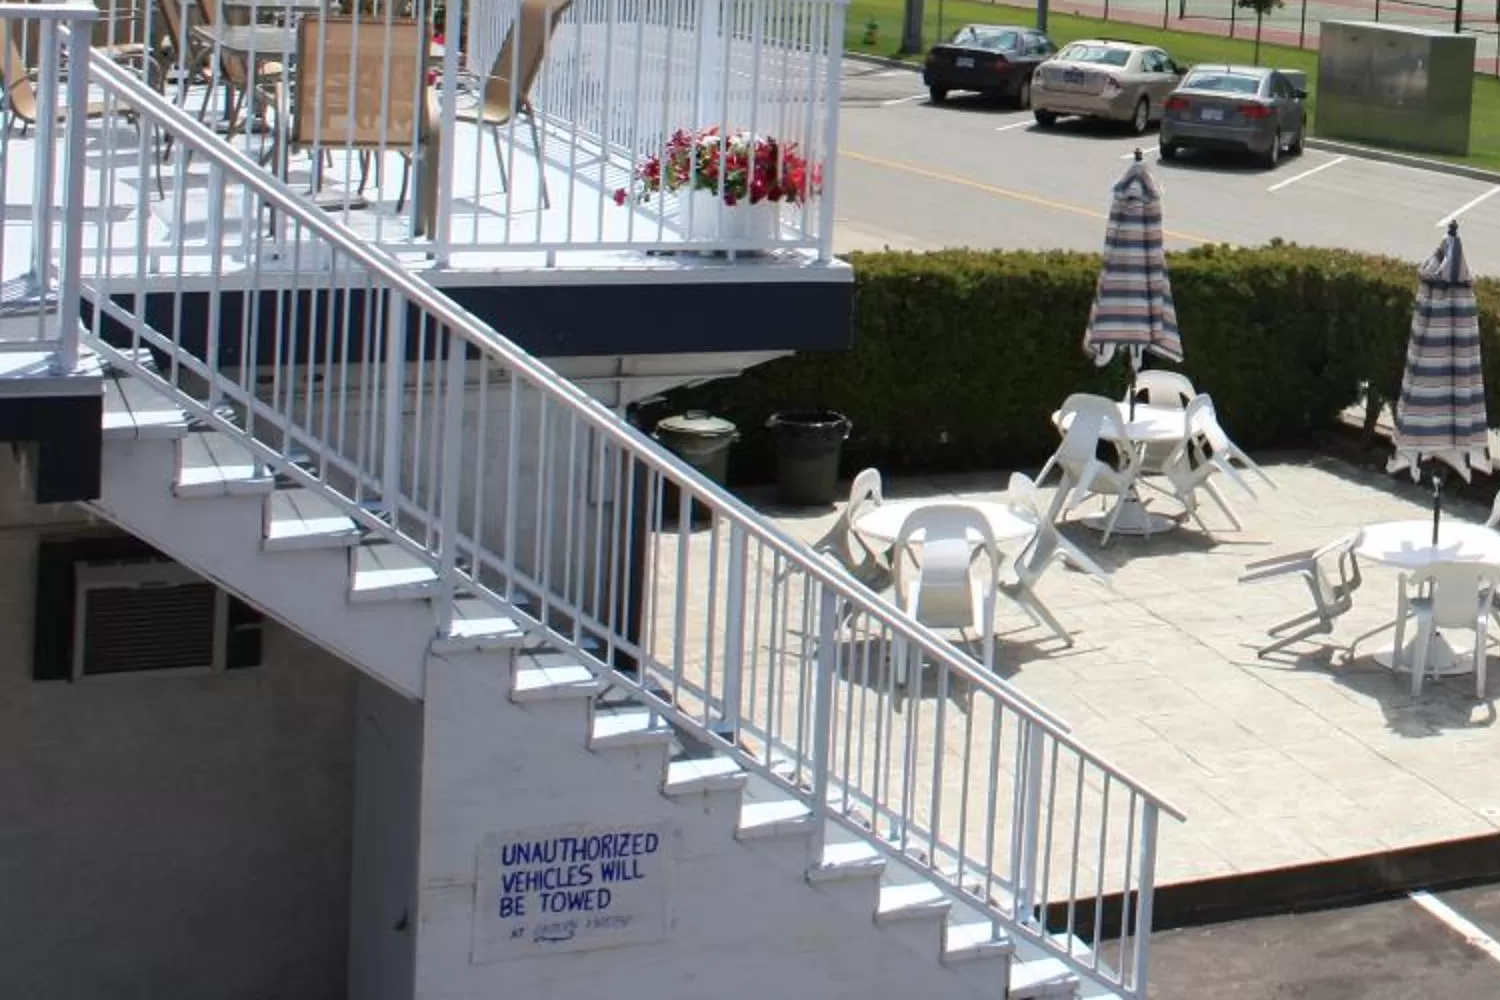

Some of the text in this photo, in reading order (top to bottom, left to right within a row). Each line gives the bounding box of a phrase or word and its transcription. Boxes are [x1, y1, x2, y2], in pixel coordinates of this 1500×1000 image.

[501, 833, 659, 866] UNAUTHORIZED
[502, 859, 645, 893] VEHICLES WILL
[499, 888, 612, 918] BE TOWED
